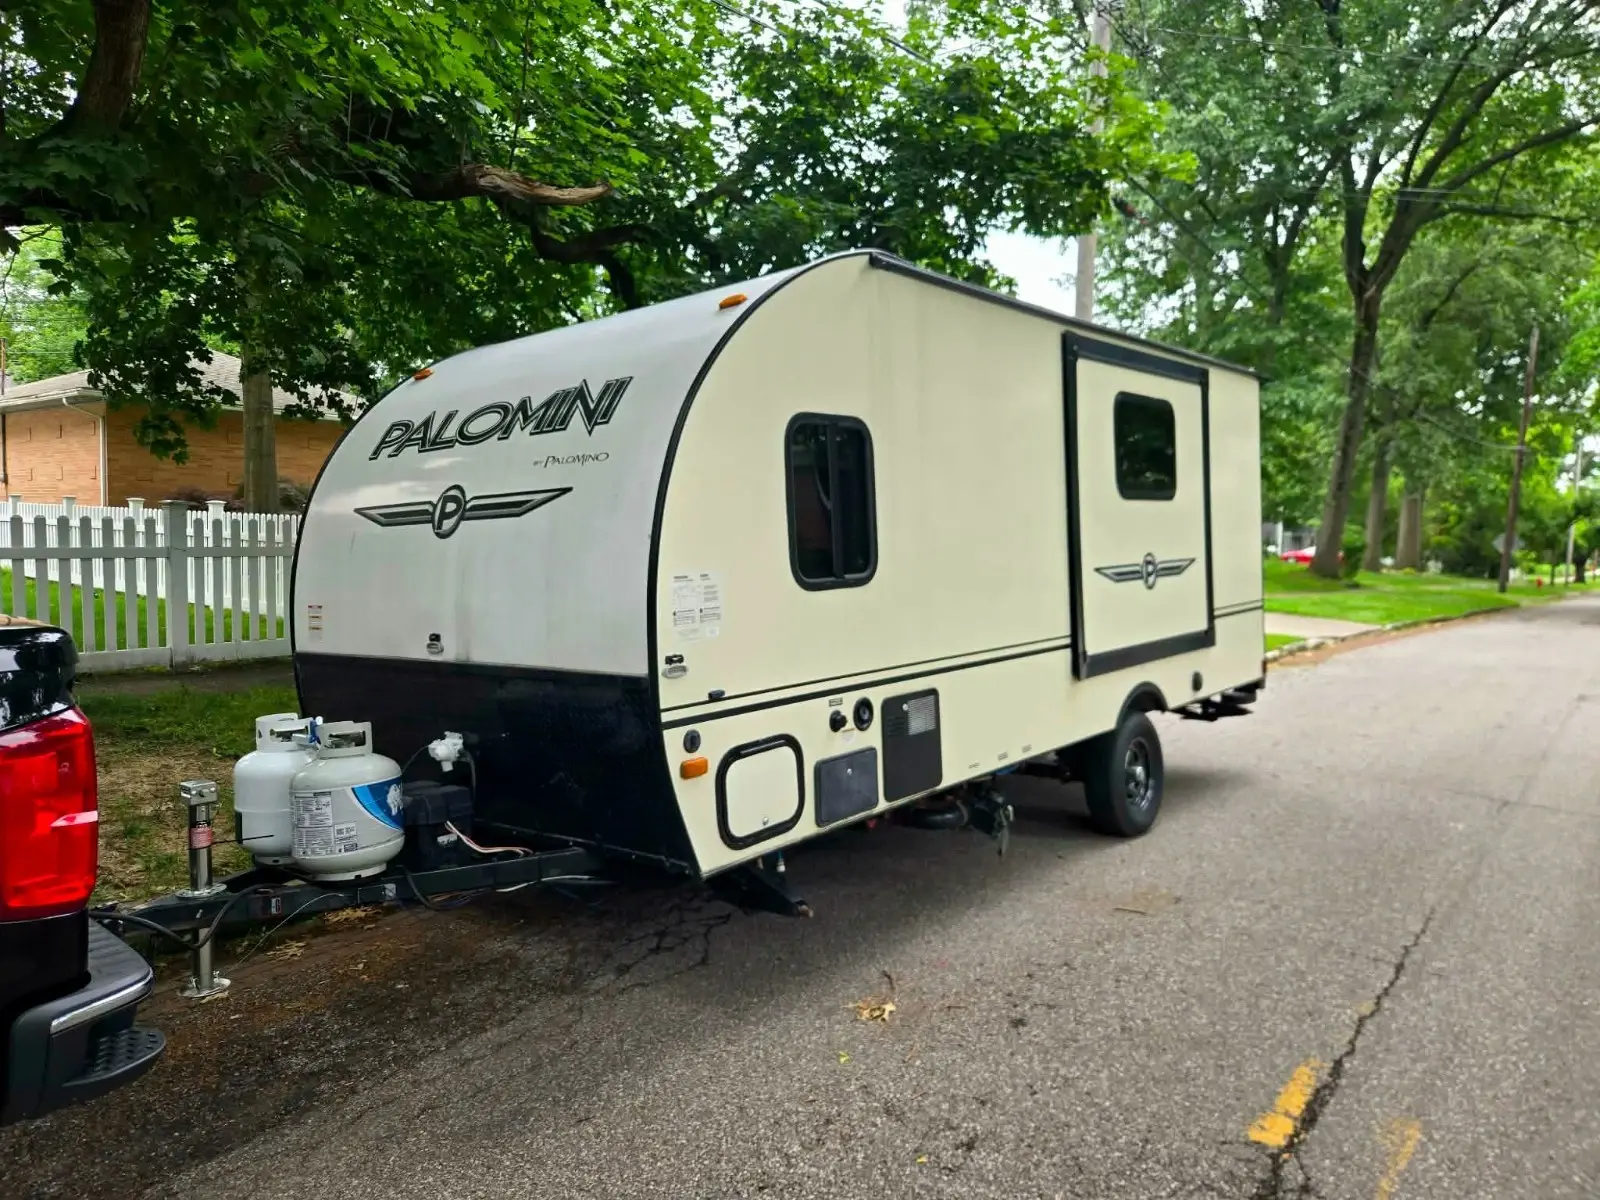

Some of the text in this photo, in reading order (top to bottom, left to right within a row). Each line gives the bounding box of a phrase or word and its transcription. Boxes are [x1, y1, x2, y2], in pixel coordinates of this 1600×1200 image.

[368, 376, 635, 461] PALOMINI
[543, 452, 610, 468] PALOMINO
[433, 494, 463, 533] P
